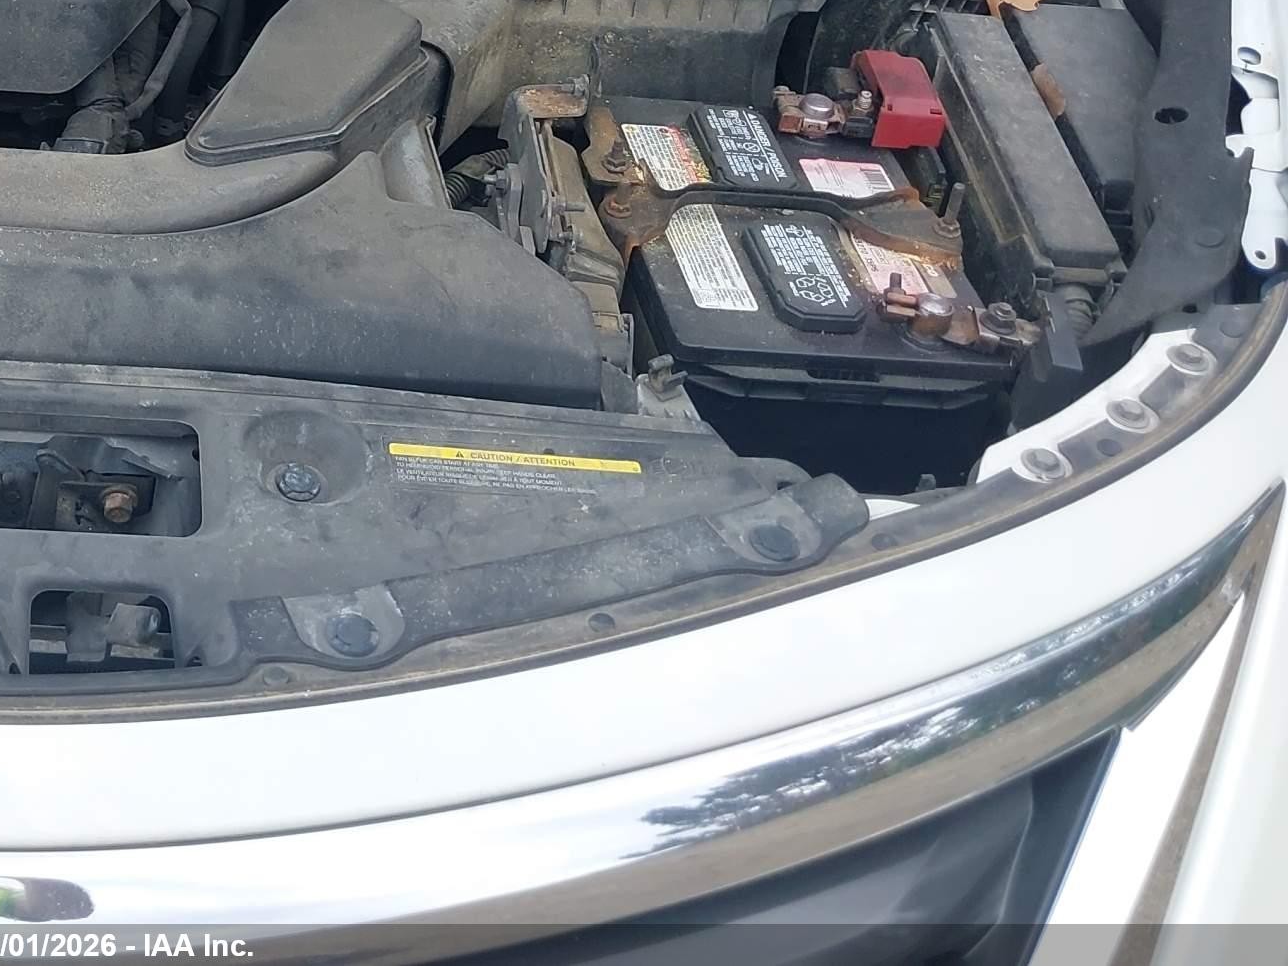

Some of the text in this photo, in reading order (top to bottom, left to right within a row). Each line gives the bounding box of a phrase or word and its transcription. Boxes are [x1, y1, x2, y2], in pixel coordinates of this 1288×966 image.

[751, 119, 771, 147] DANGER
[767, 152, 788, 178] POISON
[470, 453, 513, 462] CAUTION
[523, 456, 576, 467] ATTENTION
